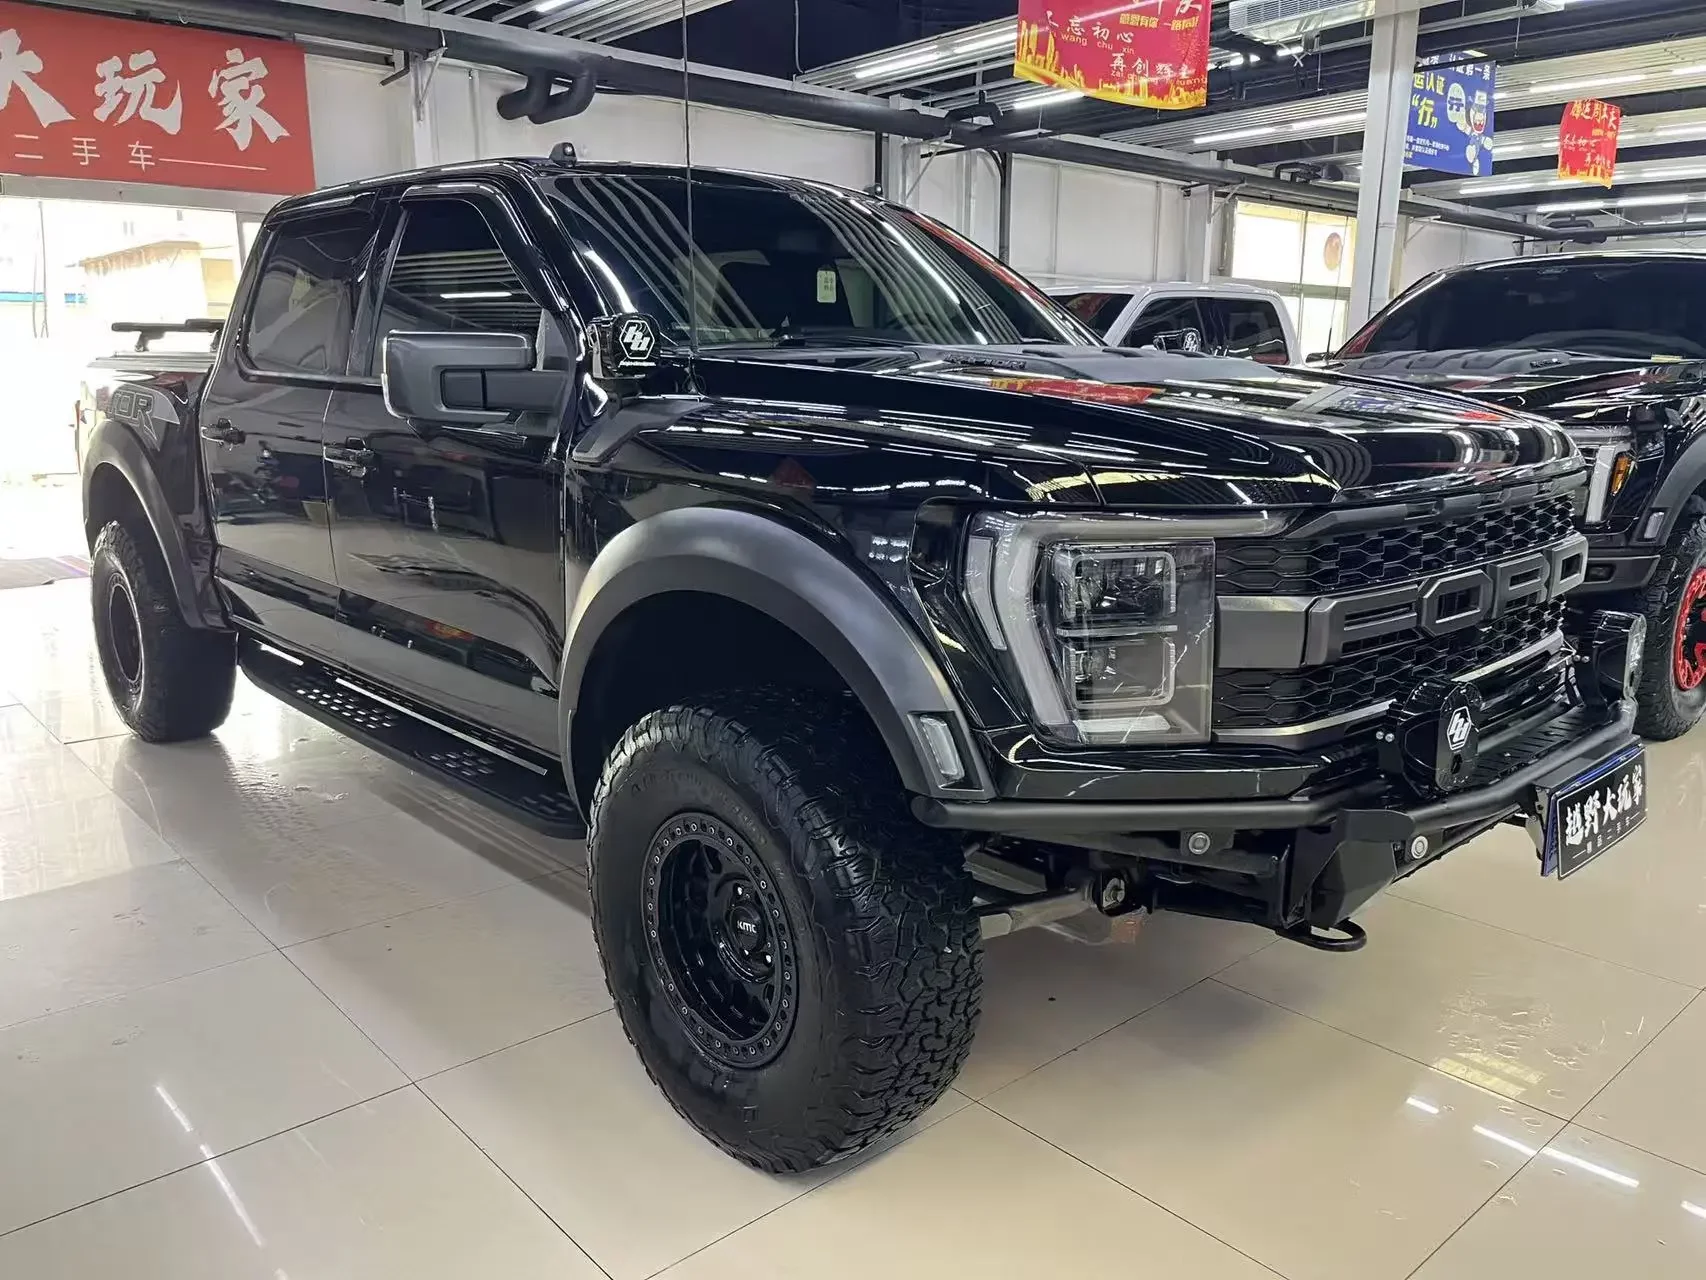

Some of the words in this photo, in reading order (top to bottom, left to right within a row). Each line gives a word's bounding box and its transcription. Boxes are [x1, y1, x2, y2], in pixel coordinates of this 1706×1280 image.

[1061, 32, 1088, 46] wang
[1096, 40, 1113, 50] chu
[0, 28, 291, 151] 大玩家
[14, 133, 155, 172] 二手车
[1306, 532, 1589, 666] FORD
